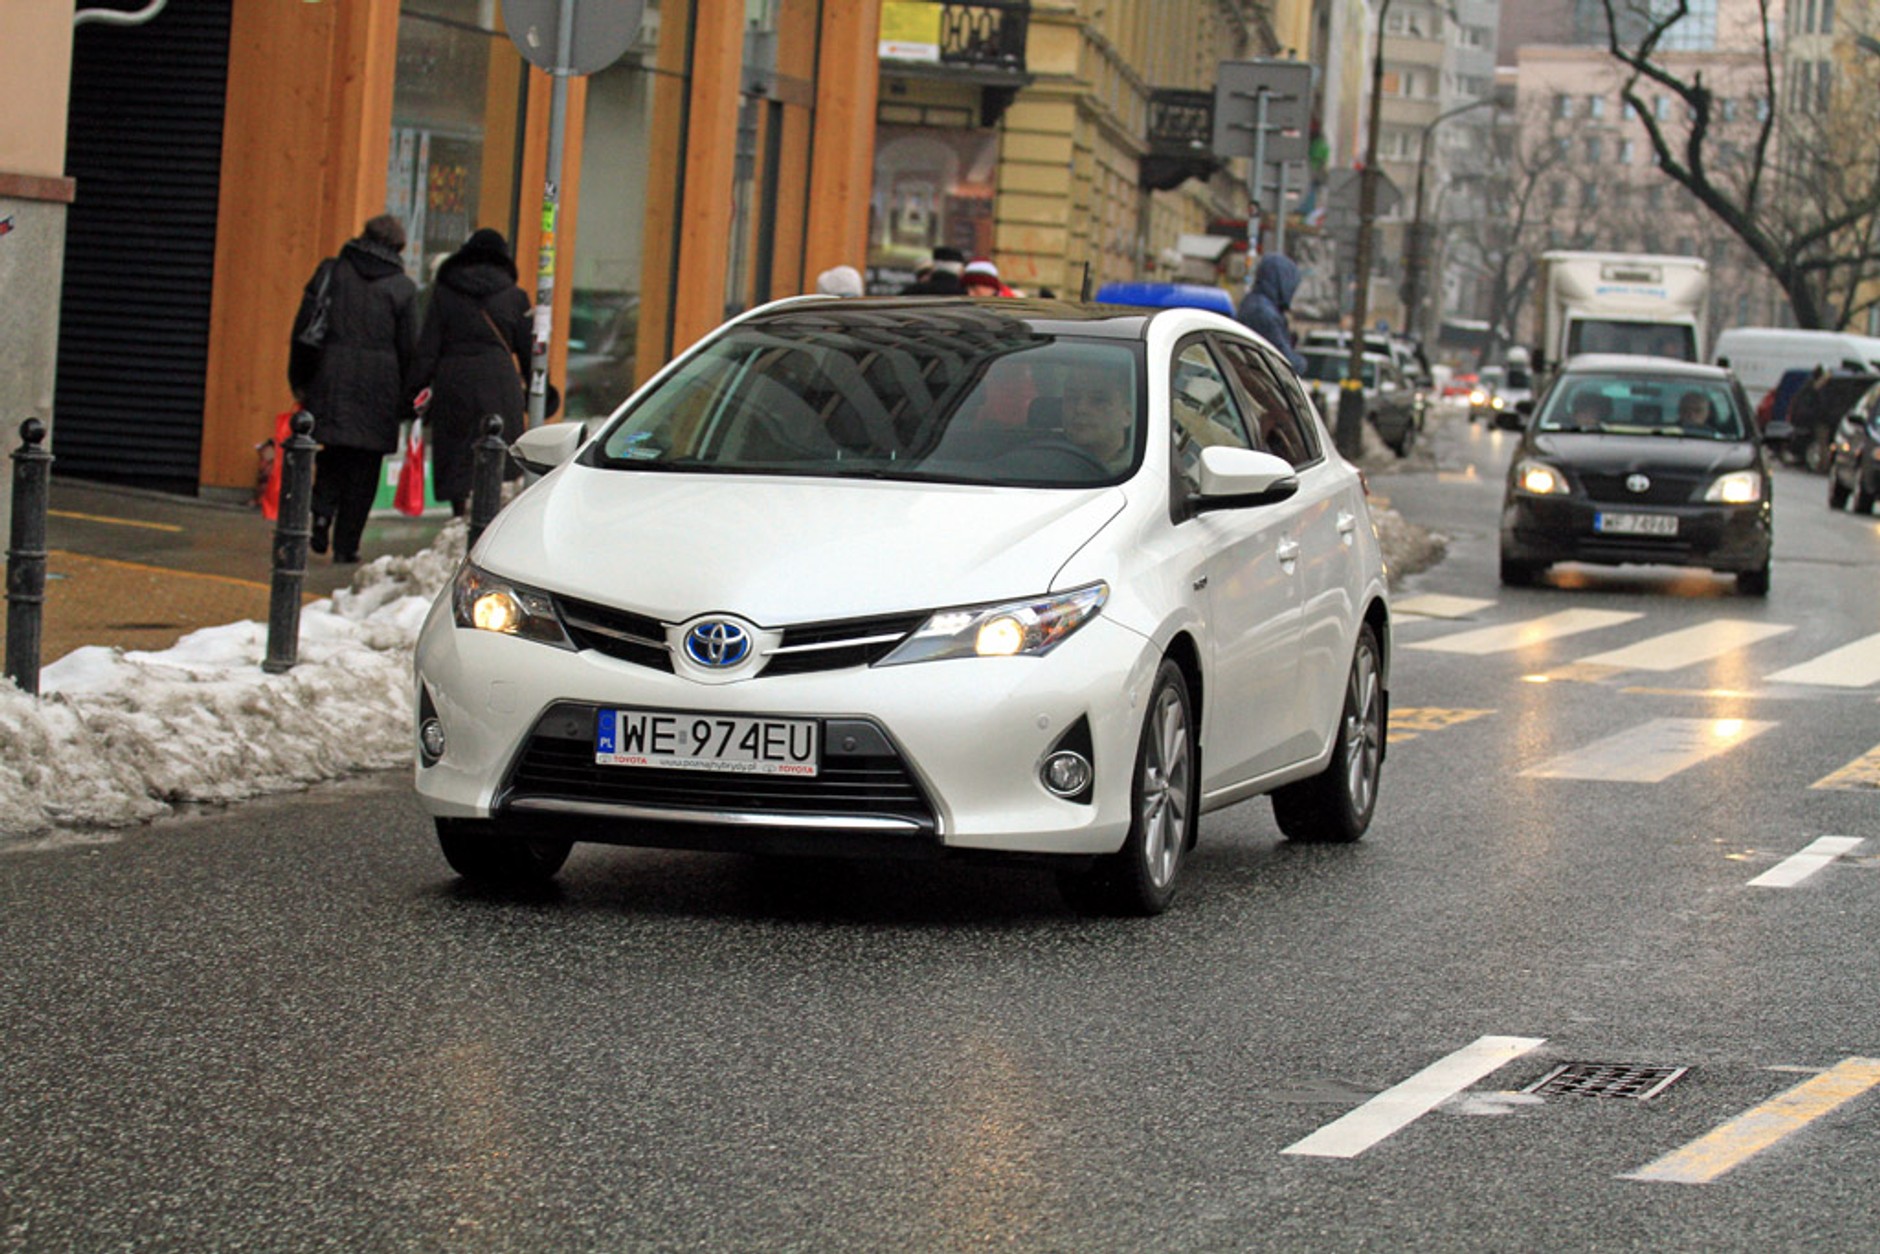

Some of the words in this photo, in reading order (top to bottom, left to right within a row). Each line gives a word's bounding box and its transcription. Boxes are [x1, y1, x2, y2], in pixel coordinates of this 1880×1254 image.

[600, 737, 613, 748] PL
[623, 715, 676, 754] WE
[692, 719, 812, 761] 974EU
[614, 755, 647, 765] TOYOTA
[778, 764, 814, 774] TOYOTA
